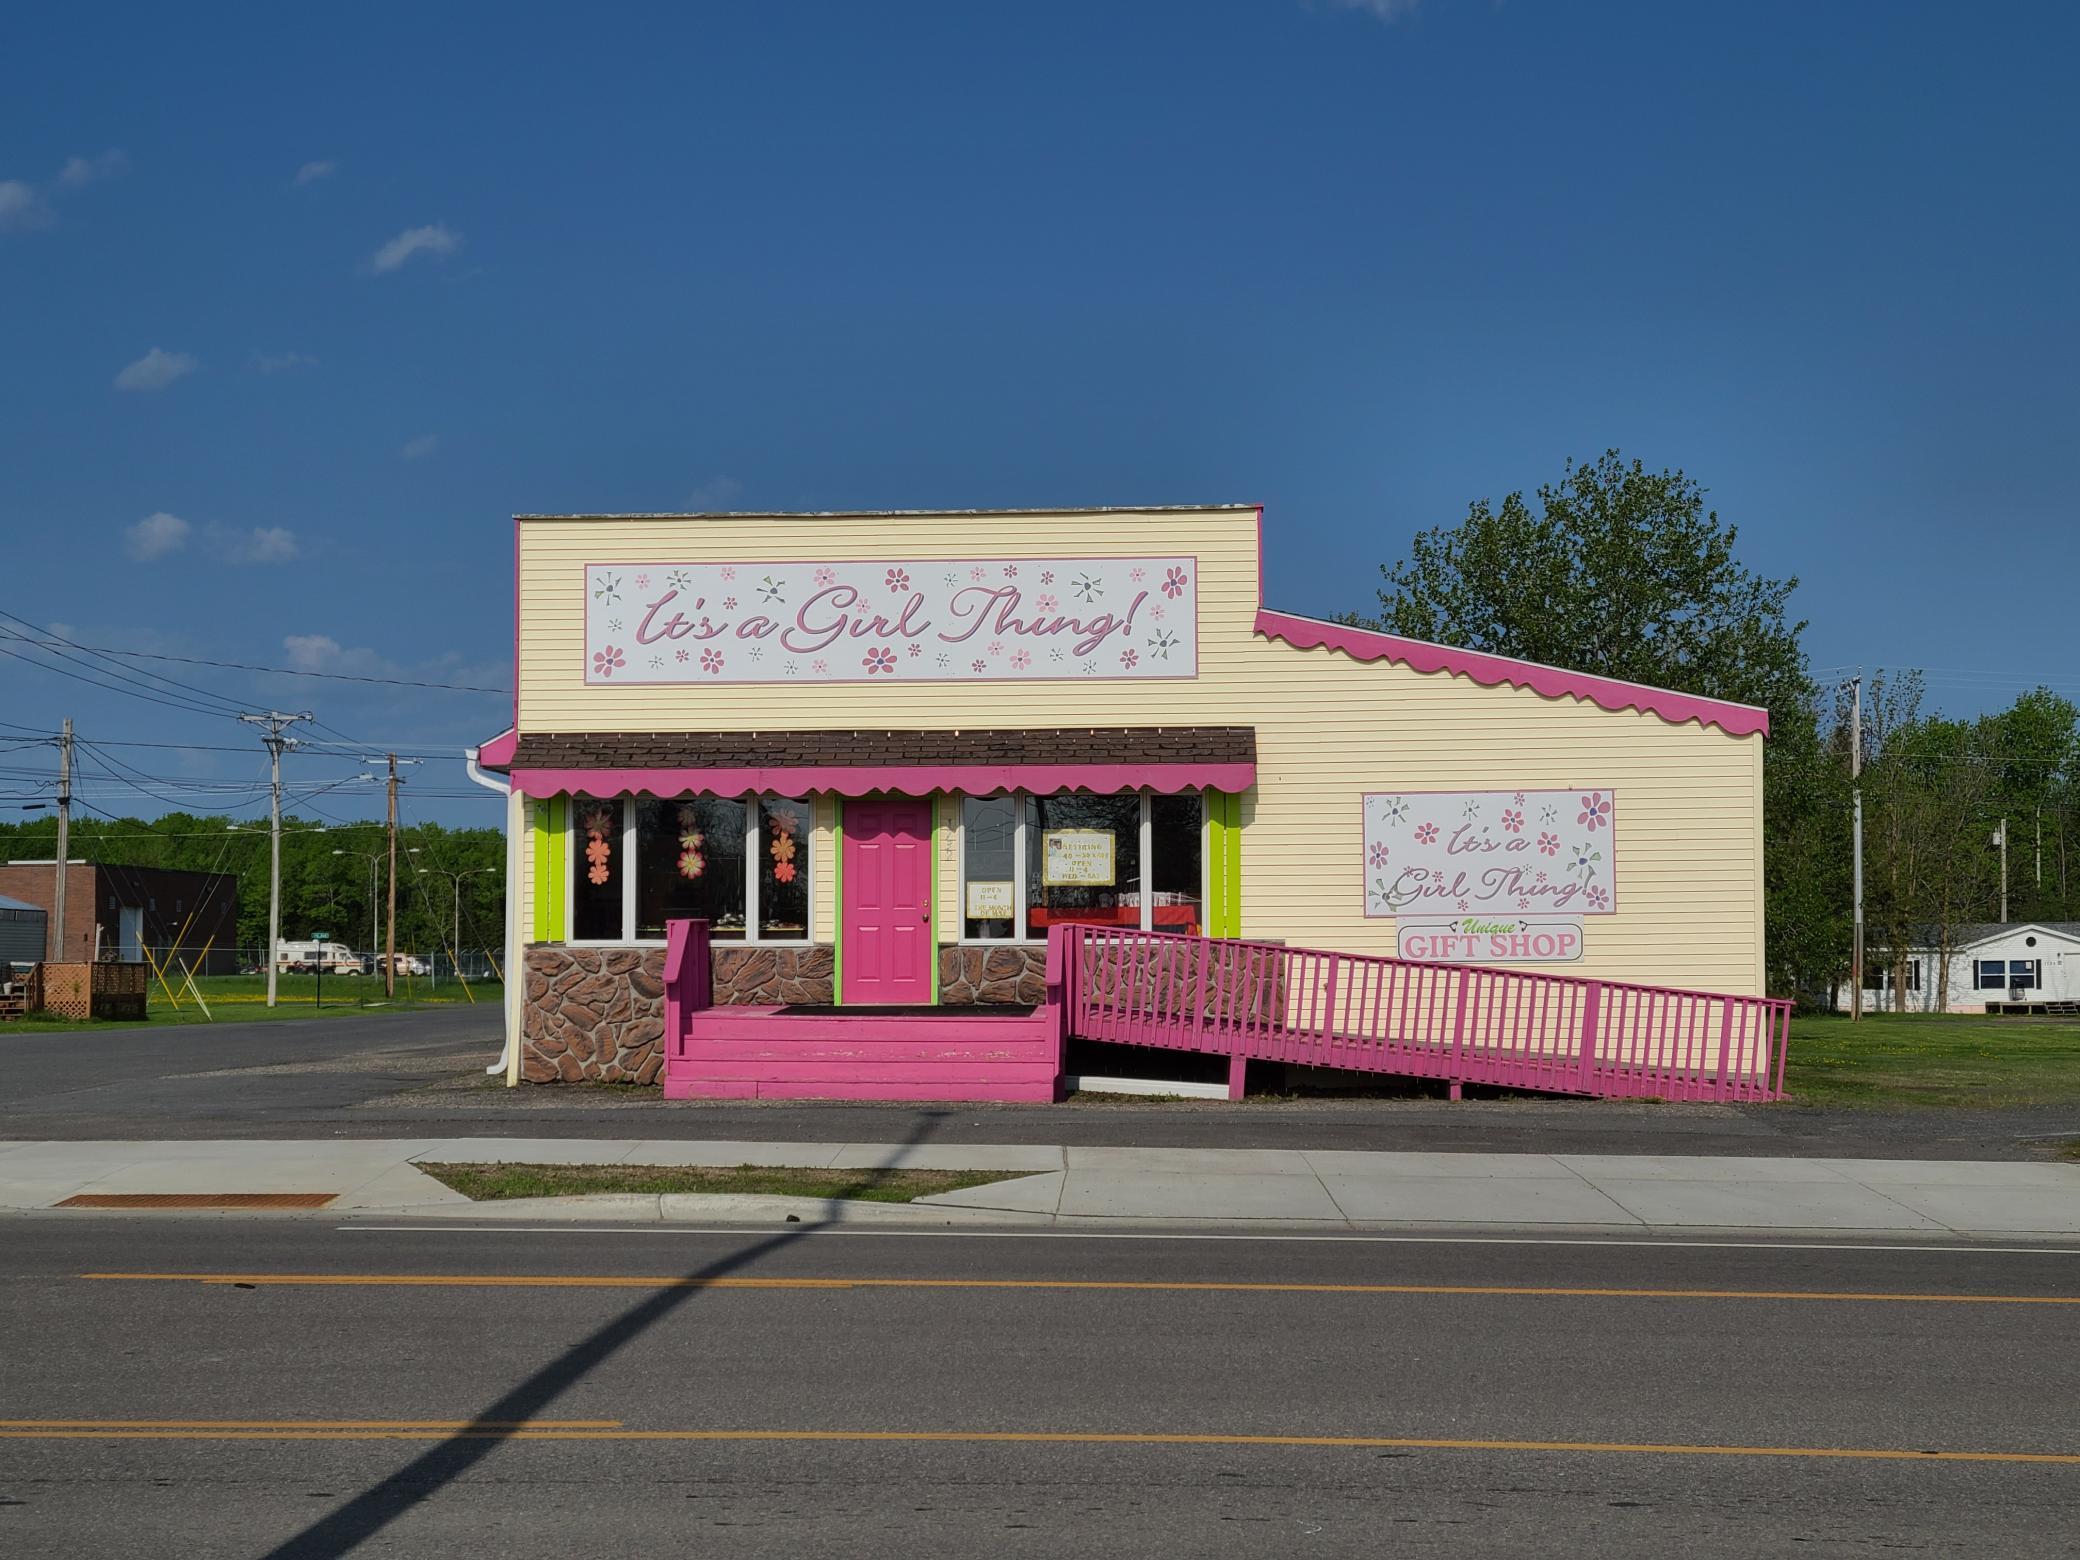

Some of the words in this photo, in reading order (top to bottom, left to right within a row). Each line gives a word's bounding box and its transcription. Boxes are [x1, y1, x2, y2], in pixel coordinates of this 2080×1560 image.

[635, 589, 730, 646] It's
[735, 617, 781, 639] a
[779, 584, 932, 655] Girl
[936, 584, 1150, 658] Thing!
[1446, 822, 1502, 856] It's
[1505, 838, 1531, 853] a
[1387, 867, 1471, 907] Girl
[1461, 917, 1517, 935] Unique
[1404, 935, 1481, 959] GIFT
[1489, 933, 1577, 958] SHOP
